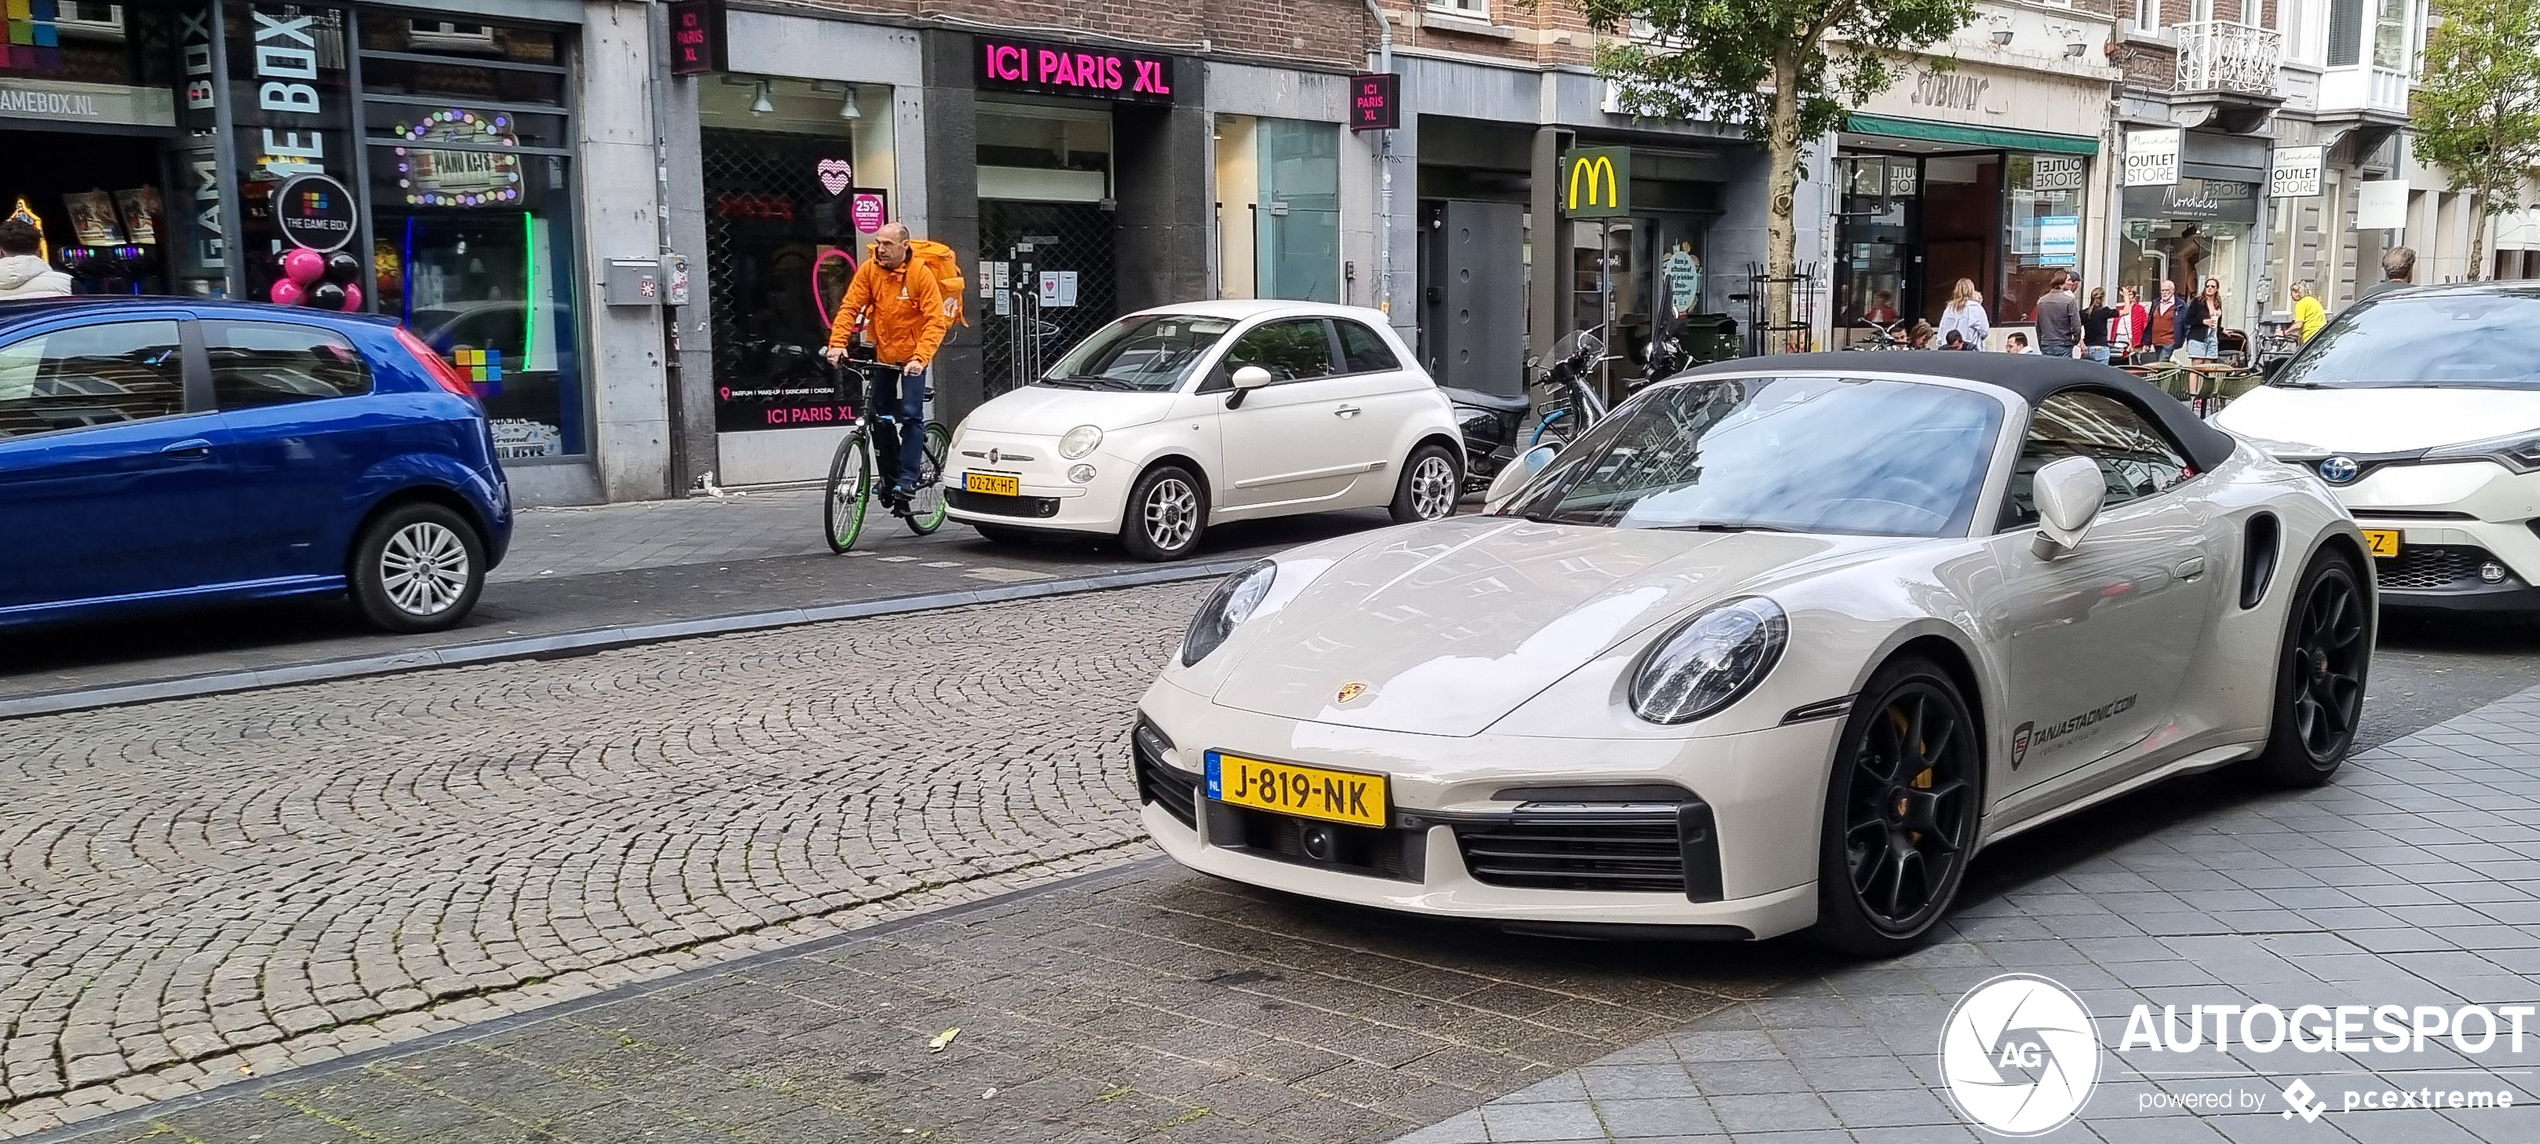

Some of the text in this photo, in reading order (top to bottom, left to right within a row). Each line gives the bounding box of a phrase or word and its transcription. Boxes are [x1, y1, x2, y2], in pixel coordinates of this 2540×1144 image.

[677, 13, 703, 61] ICI PARIS XL
[180, 8, 215, 110] BOX
[253, 11, 320, 114] BOX
[987, 45, 1170, 94] ICI PARIS XL
[1911, 70, 1989, 111] SUBWAY
[0, 90, 98, 116] AMEBOX.NL
[1357, 84, 1384, 121] ICI PARIS XL
[2128, 153, 2175, 167] OUTLET
[2127, 166, 2174, 183] STORE
[2274, 168, 2317, 180] OUTLET
[2273, 180, 2316, 194] STORE
[856, 200, 879, 212] 25%
[286, 217, 349, 231] THE GAME BOX
[767, 405, 857, 424] ICI PARIS XL
[969, 475, 1014, 494] 02-ZK-HF
[1209, 764, 1370, 818] NL J-819-NK
